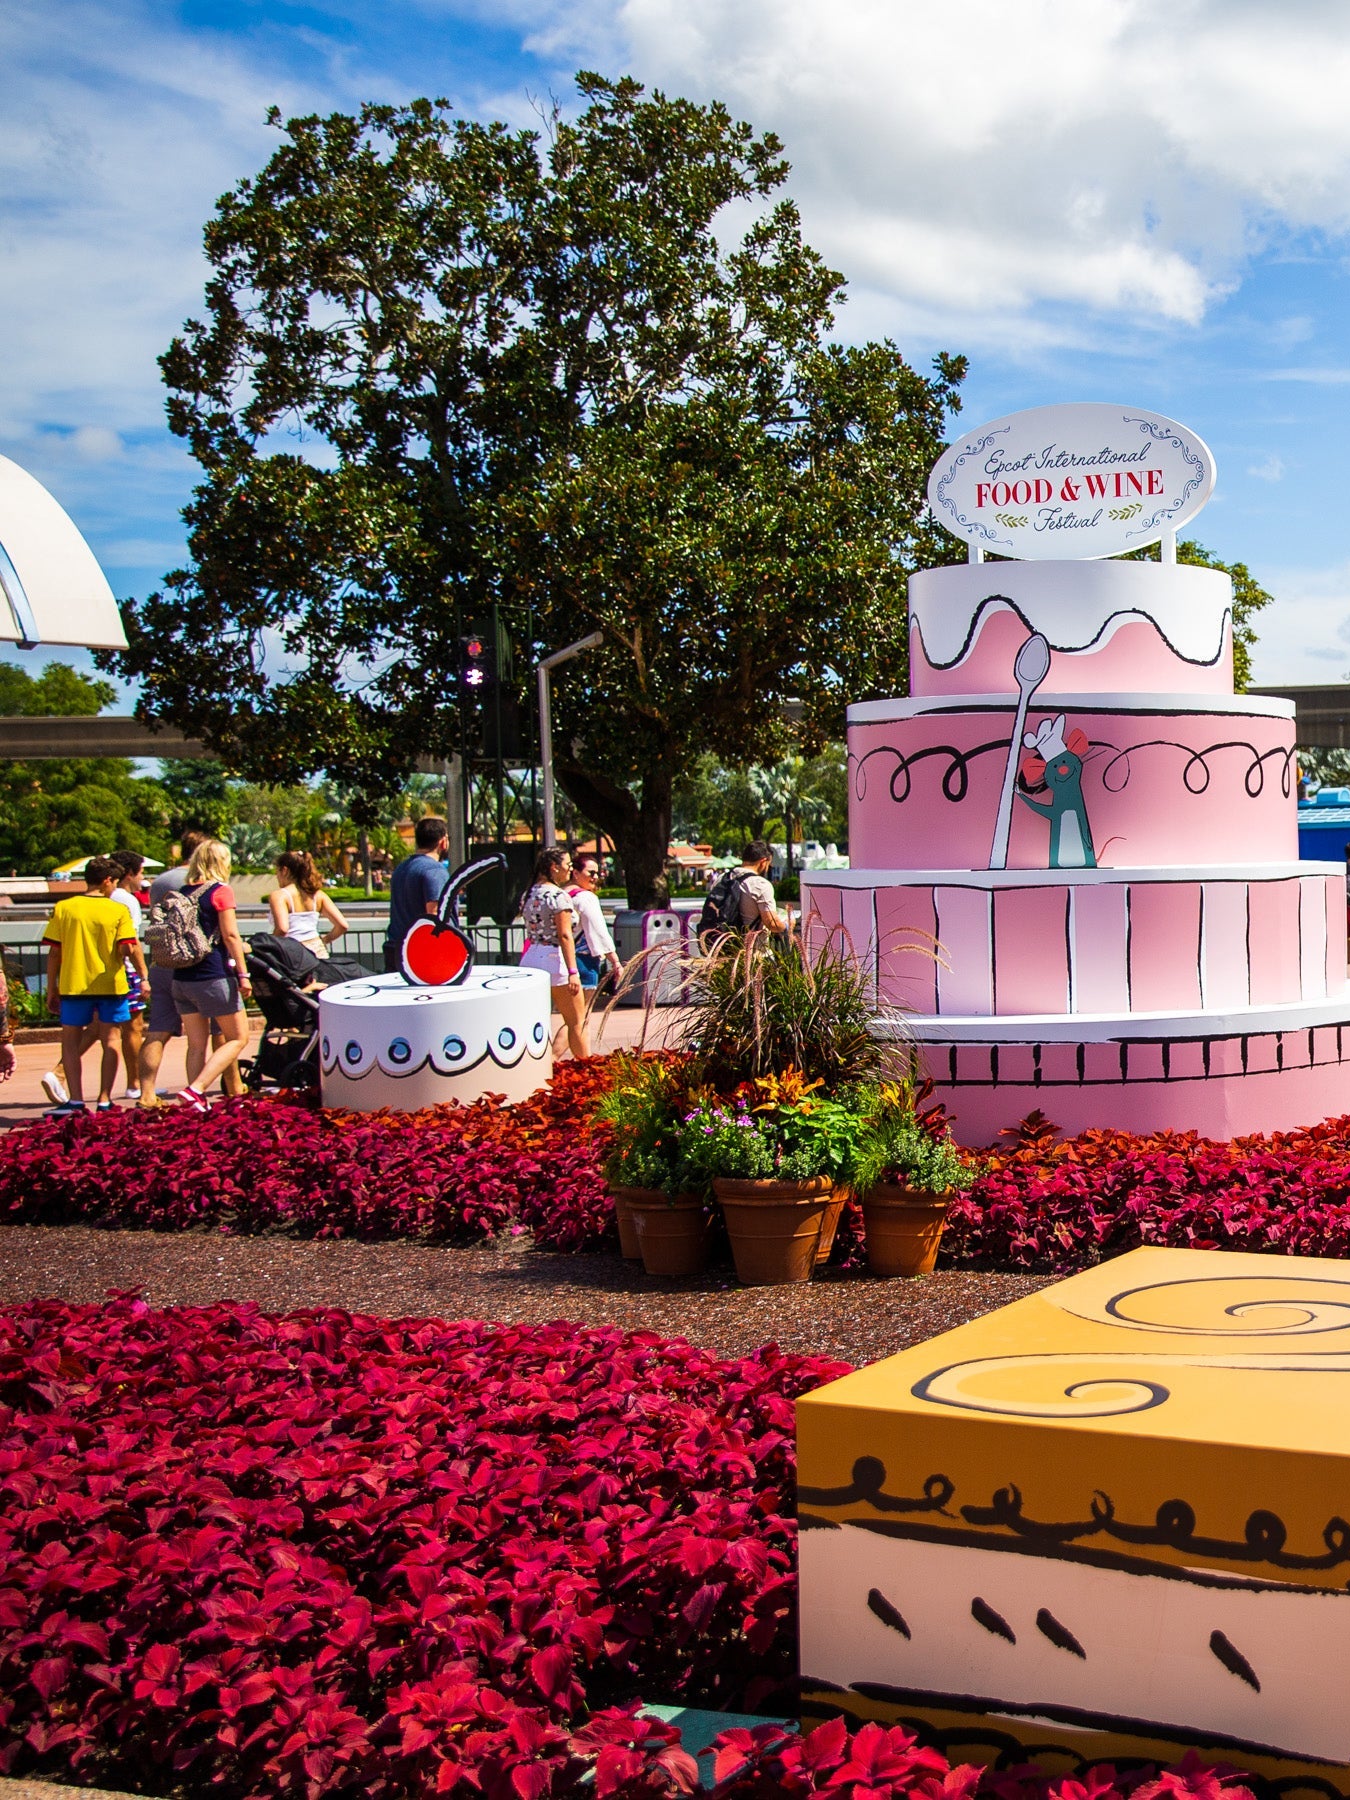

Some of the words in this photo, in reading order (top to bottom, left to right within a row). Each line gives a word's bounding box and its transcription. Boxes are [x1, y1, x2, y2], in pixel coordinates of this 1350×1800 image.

[984, 449, 1036, 480] Epcot
[1034, 442, 1152, 470] International
[975, 478, 1053, 508] FOOD
[1060, 475, 1082, 501] &
[1082, 469, 1164, 500] WINE
[1033, 506, 1104, 532] Festival
